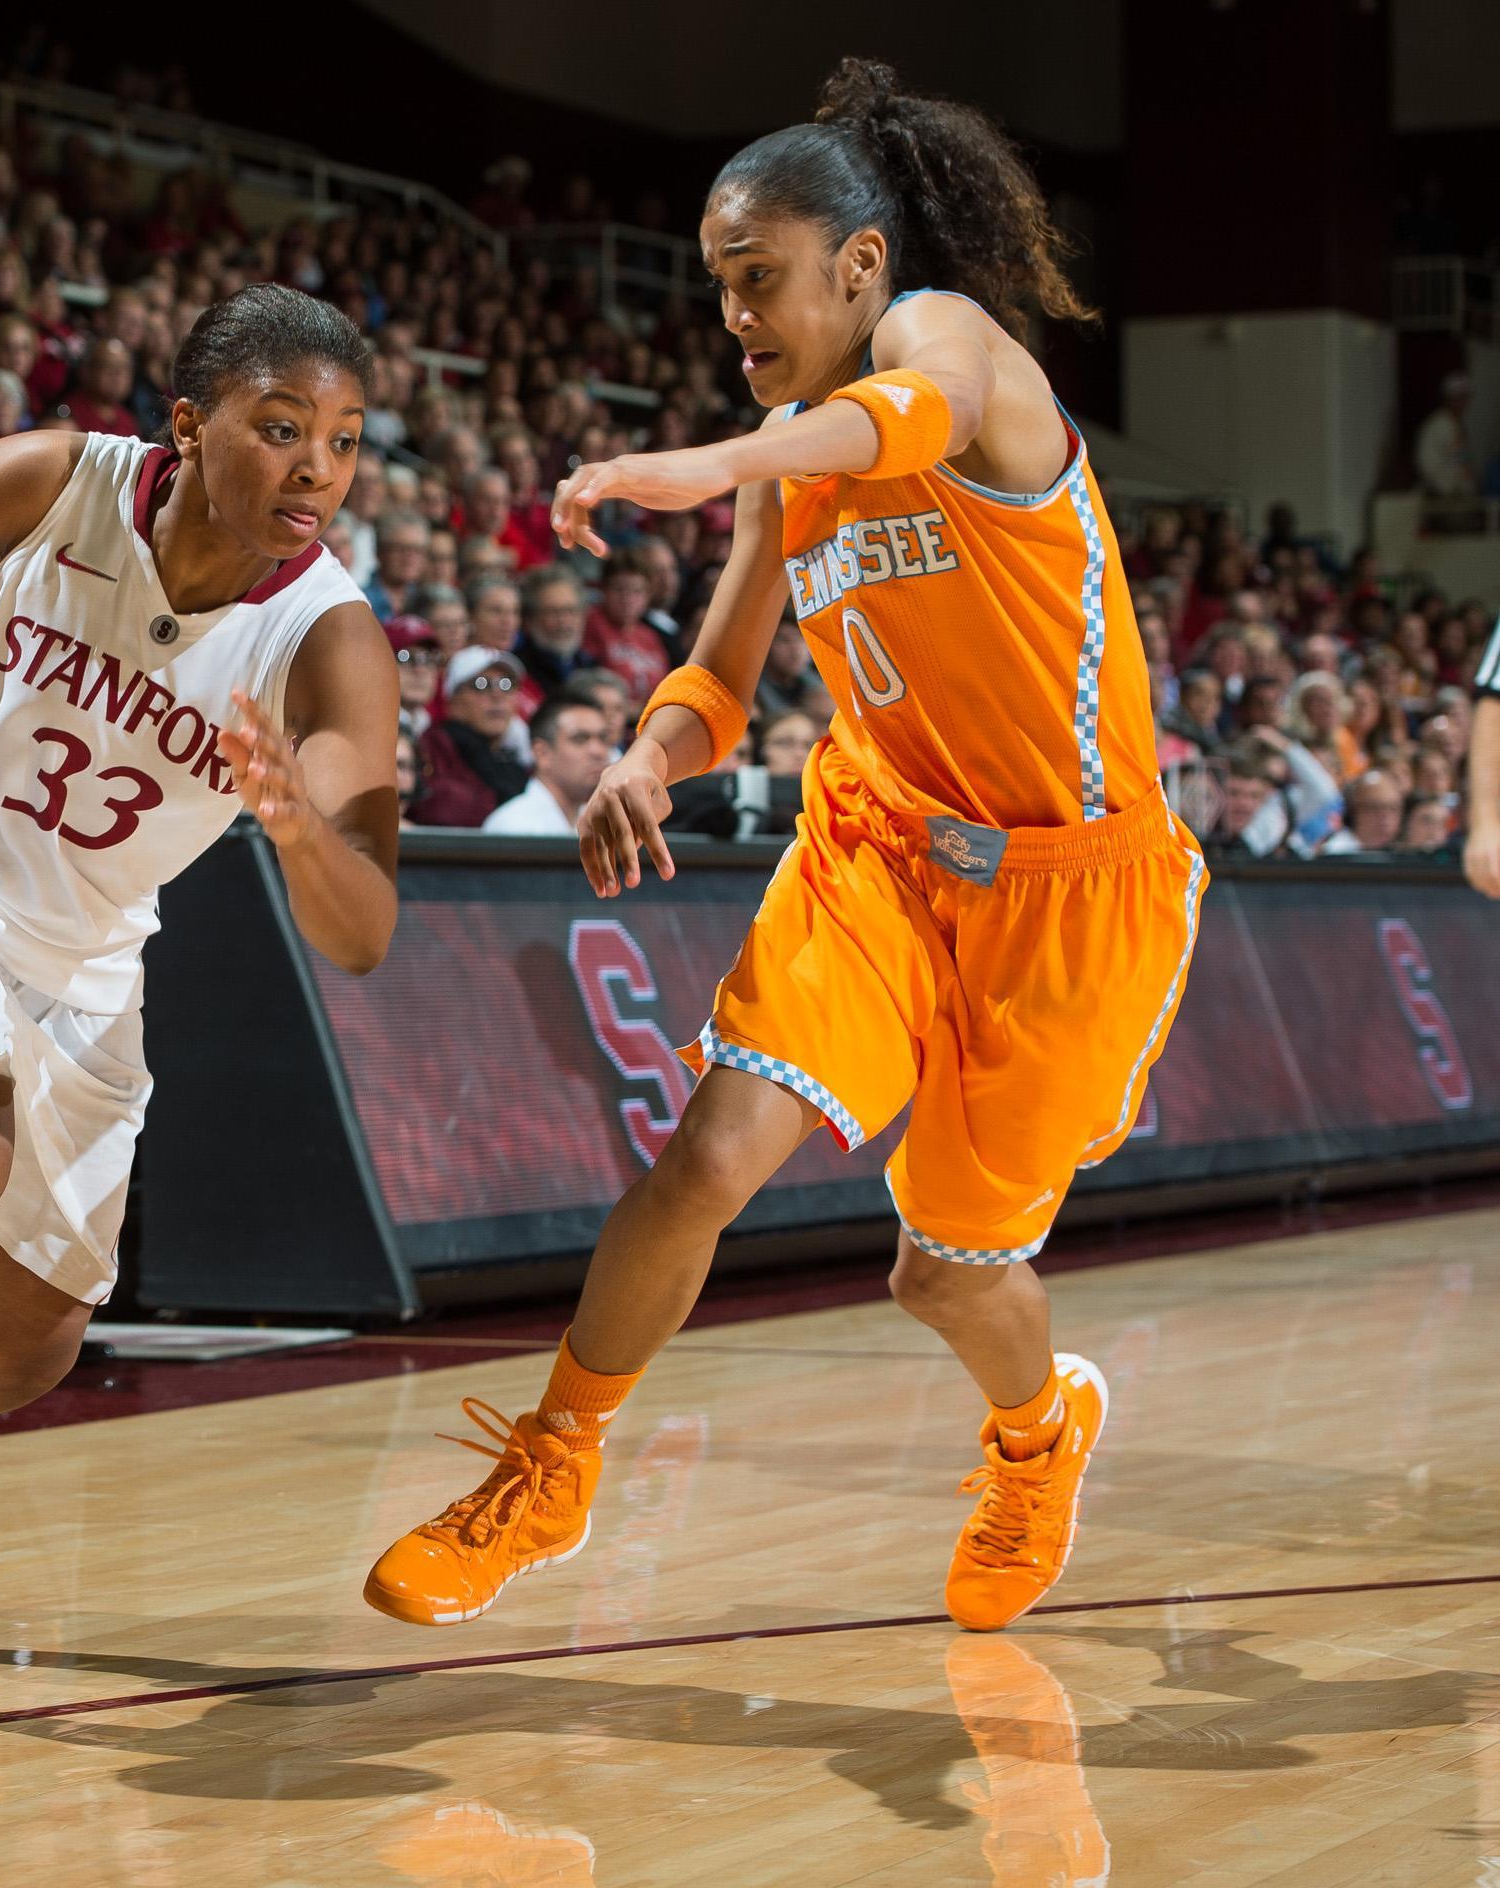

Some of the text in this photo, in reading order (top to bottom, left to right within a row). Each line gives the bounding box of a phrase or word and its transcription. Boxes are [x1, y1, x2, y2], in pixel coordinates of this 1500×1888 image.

[843, 607, 907, 711] 0
[2, 727, 164, 850] 33
[568, 919, 692, 1168] S
[1375, 917, 1475, 1111] S
